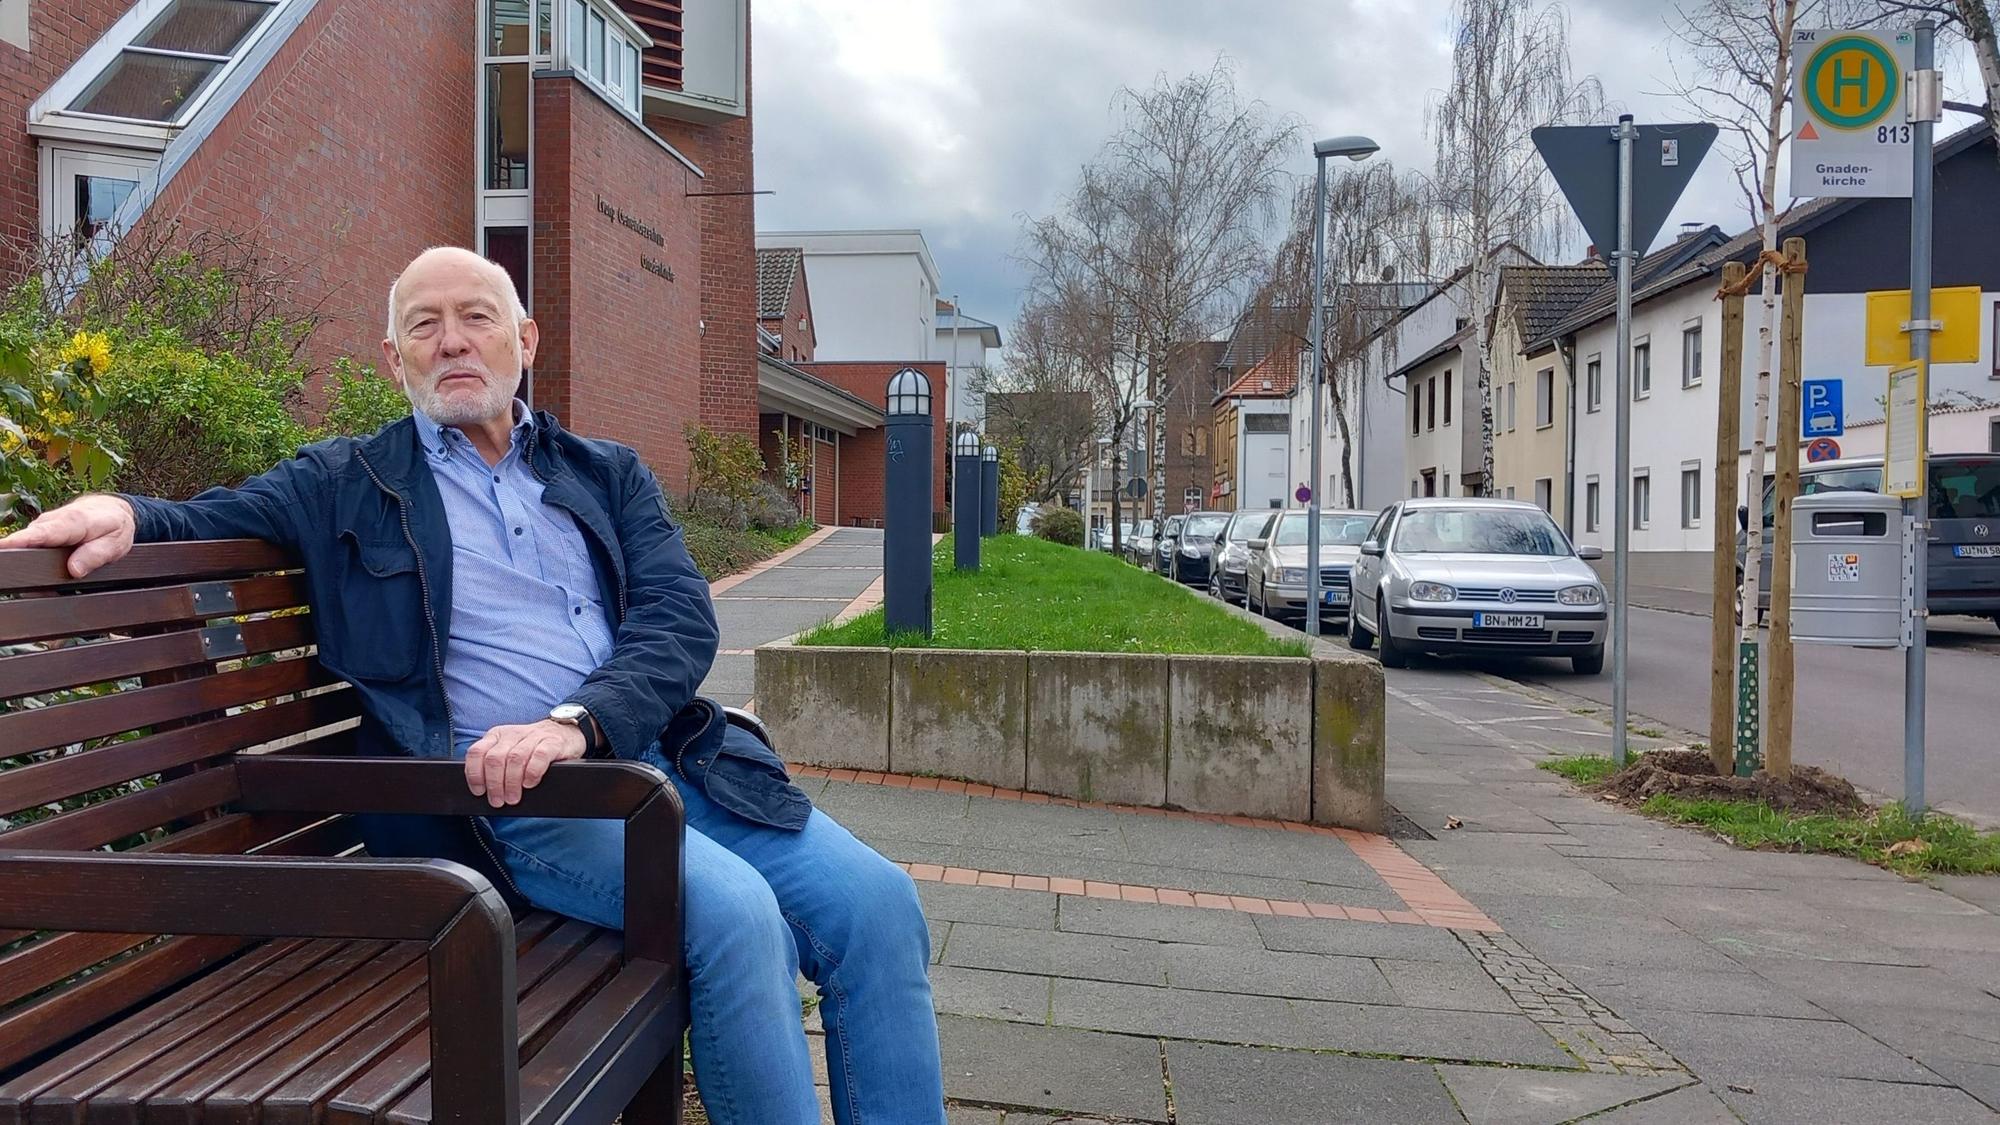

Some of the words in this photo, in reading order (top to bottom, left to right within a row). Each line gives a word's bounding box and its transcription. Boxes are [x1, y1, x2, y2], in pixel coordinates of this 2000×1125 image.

[1833, 59, 1869, 108] H
[1877, 126, 1910, 144] 813
[1816, 164, 1873, 174] Gnaden-
[1822, 176, 1866, 186] kirche
[1810, 385, 1827, 408] P
[1484, 615, 1500, 626] BN
[1507, 615, 1523, 626] MM
[1525, 616, 1539, 627] 21
